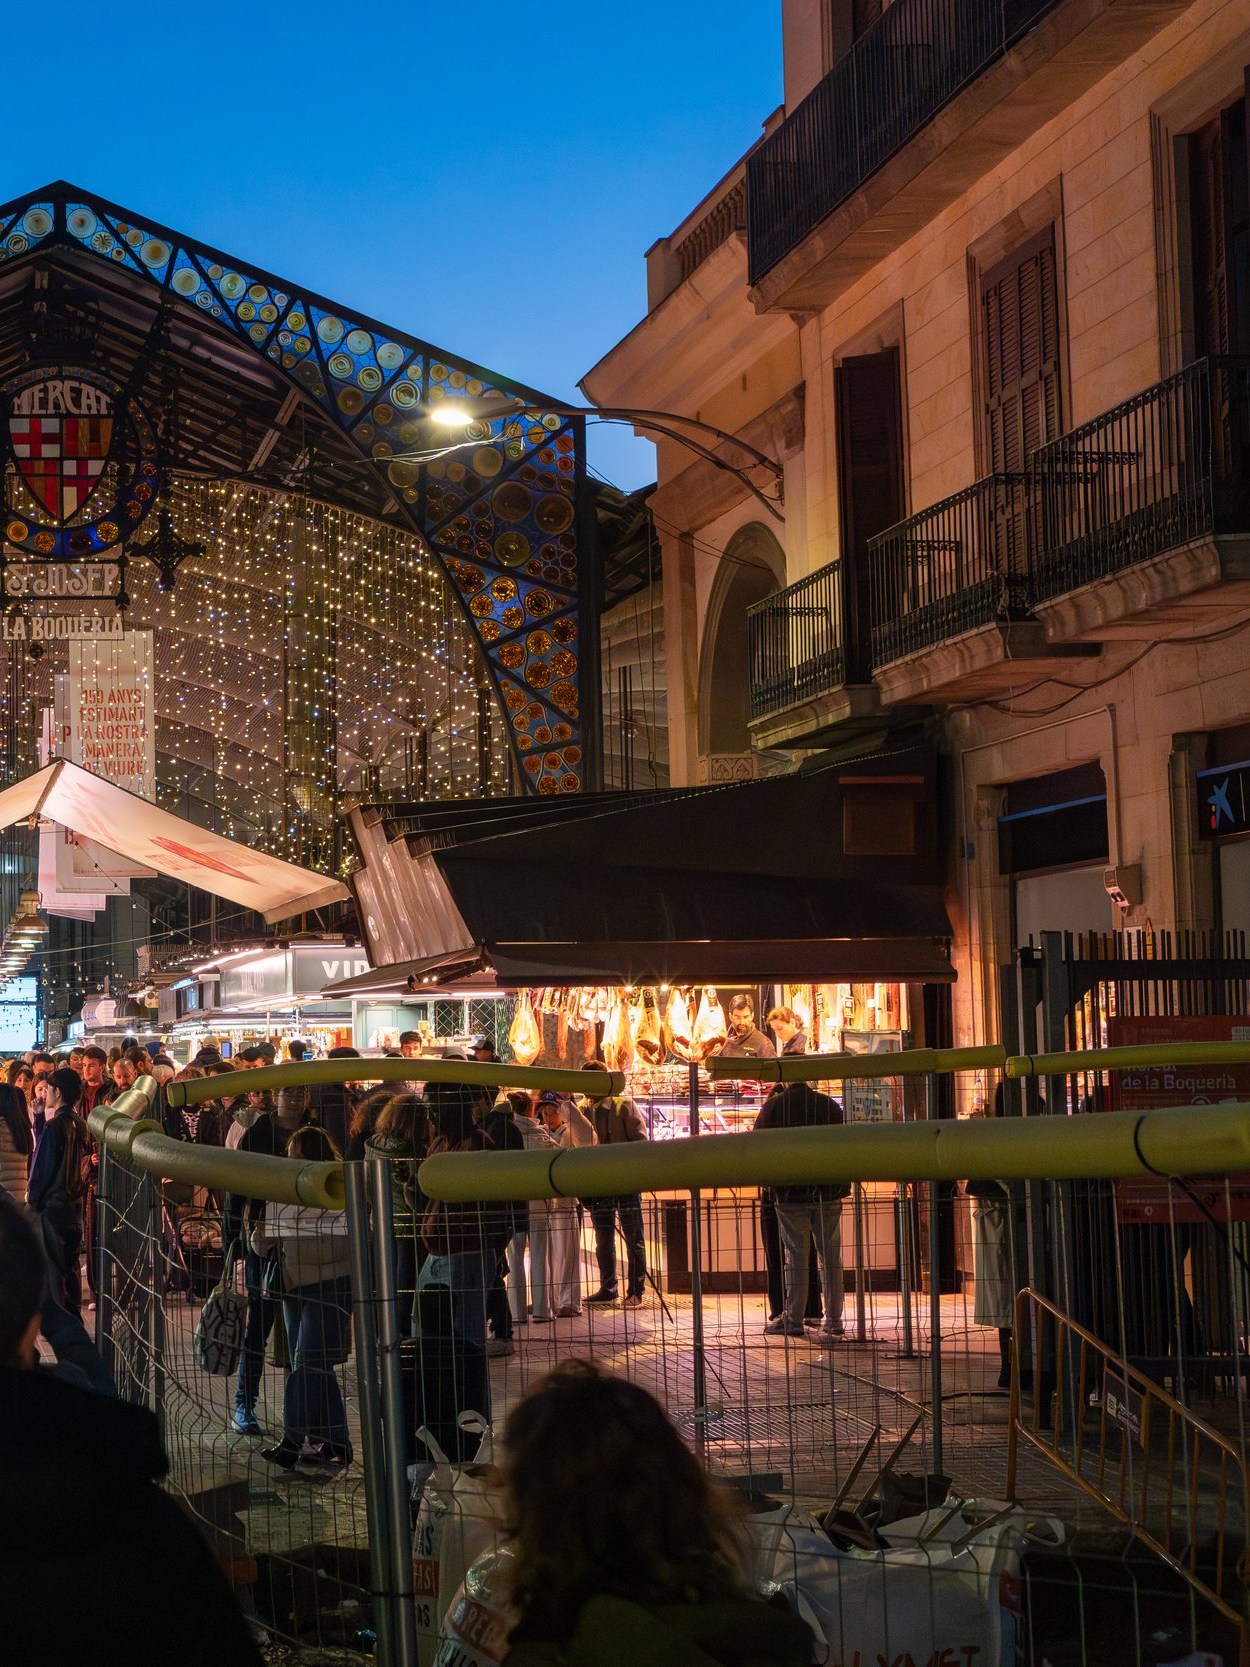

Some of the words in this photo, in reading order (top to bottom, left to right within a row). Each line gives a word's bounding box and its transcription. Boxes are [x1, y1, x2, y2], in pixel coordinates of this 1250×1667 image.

[32, 562, 120, 597] JOSEP
[2, 615, 27, 640] LA
[31, 615, 123, 640] BOQUERIA
[107, 688, 142, 704] ANYS
[79, 707, 146, 722] ESTIMANT
[96, 724, 149, 740] NOSTRA
[85, 742, 141, 758] MANERA
[103, 760, 144, 776] VIURE
[1145, 1074, 1159, 1090] la
